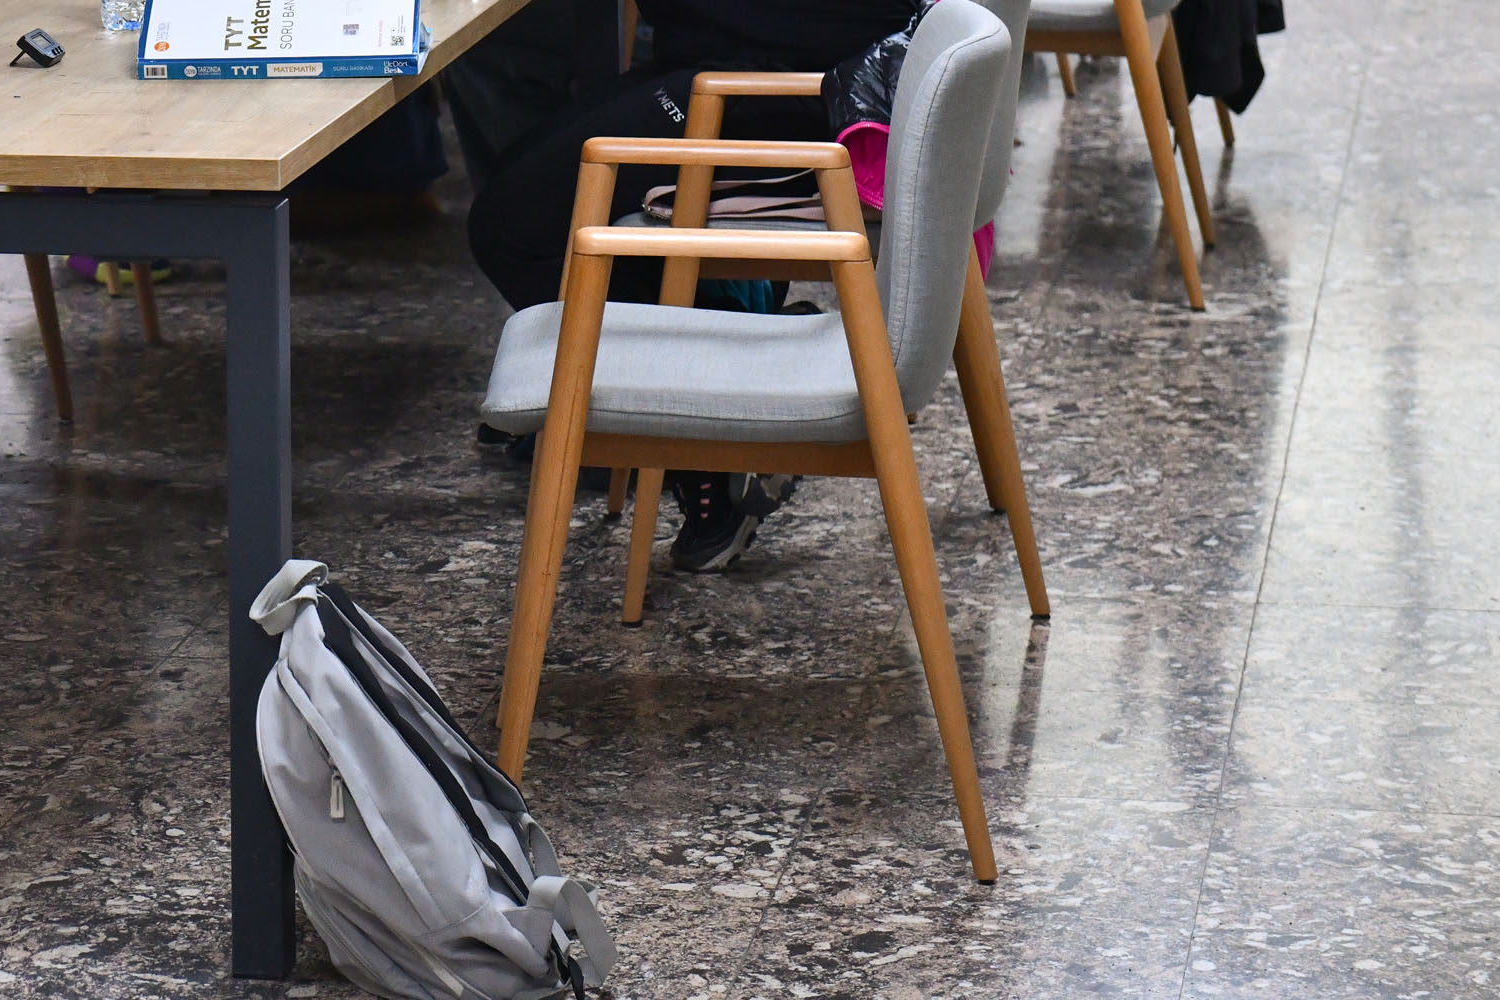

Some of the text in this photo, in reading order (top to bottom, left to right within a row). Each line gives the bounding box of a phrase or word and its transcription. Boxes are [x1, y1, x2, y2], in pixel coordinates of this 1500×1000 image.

[224, 16, 244, 51] TYT
[280, 20, 294, 50] SORU
[231, 65, 259, 76] TYT
[273, 64, 317, 73] MATEMATİK
